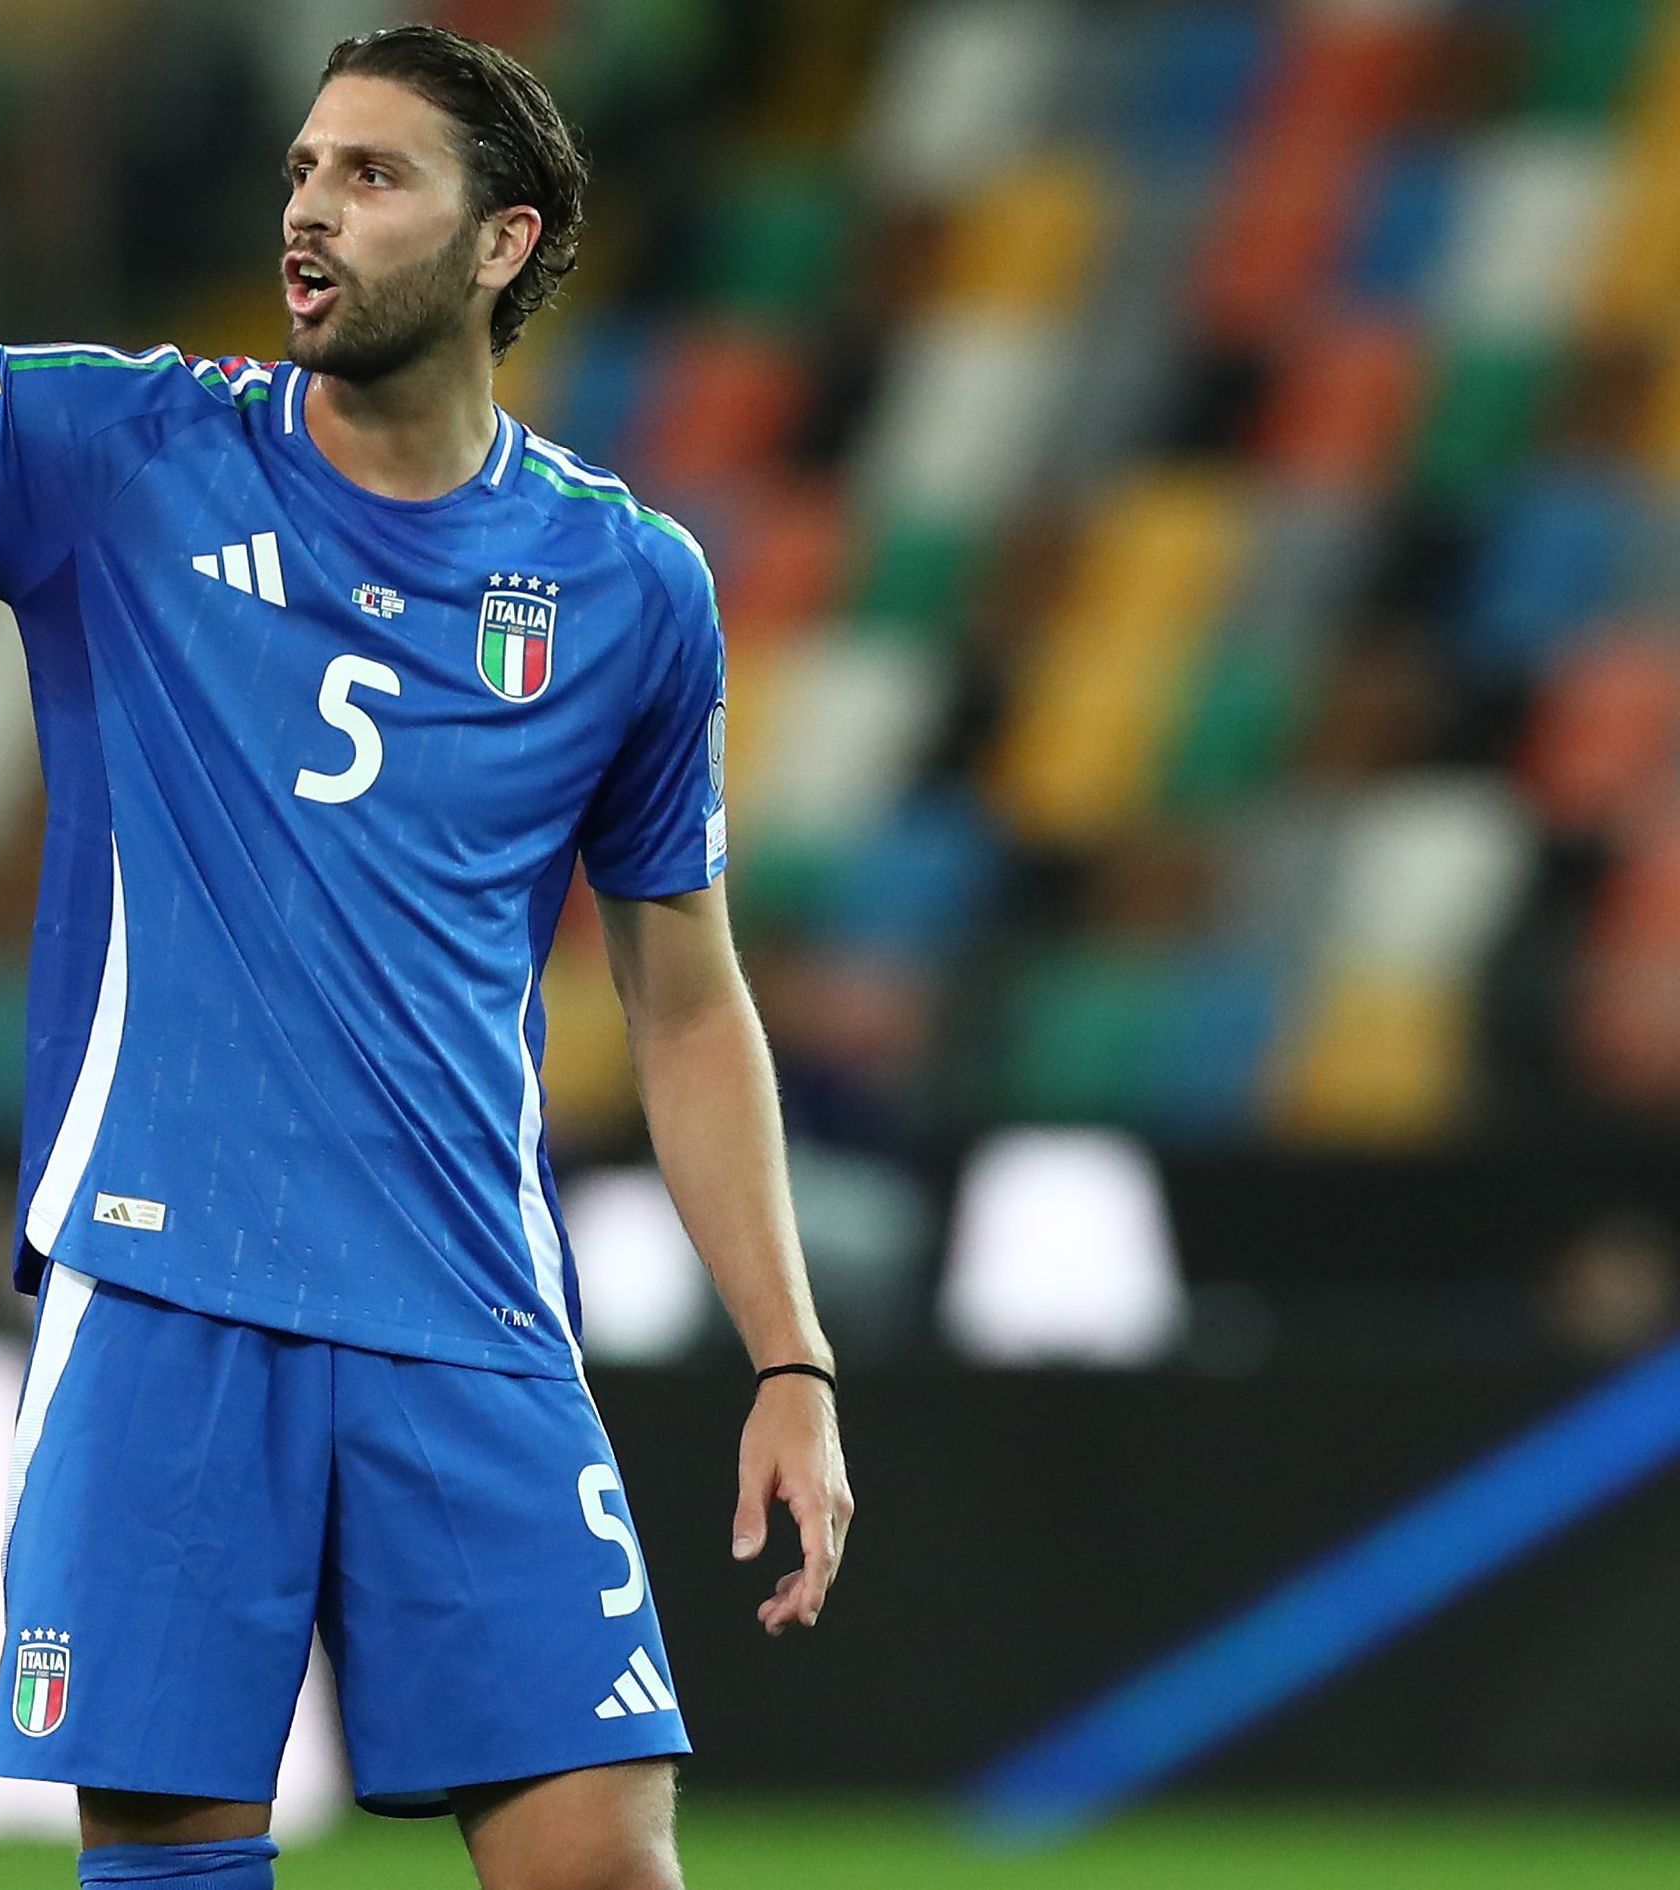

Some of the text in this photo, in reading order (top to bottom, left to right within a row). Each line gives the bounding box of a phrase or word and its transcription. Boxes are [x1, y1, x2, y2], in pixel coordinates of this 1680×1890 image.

[487, 599, 547, 629] ITALIA
[294, 653, 401, 804] 5
[577, 1463, 645, 1618] 5
[22, 1651, 65, 1671] ITALIA
